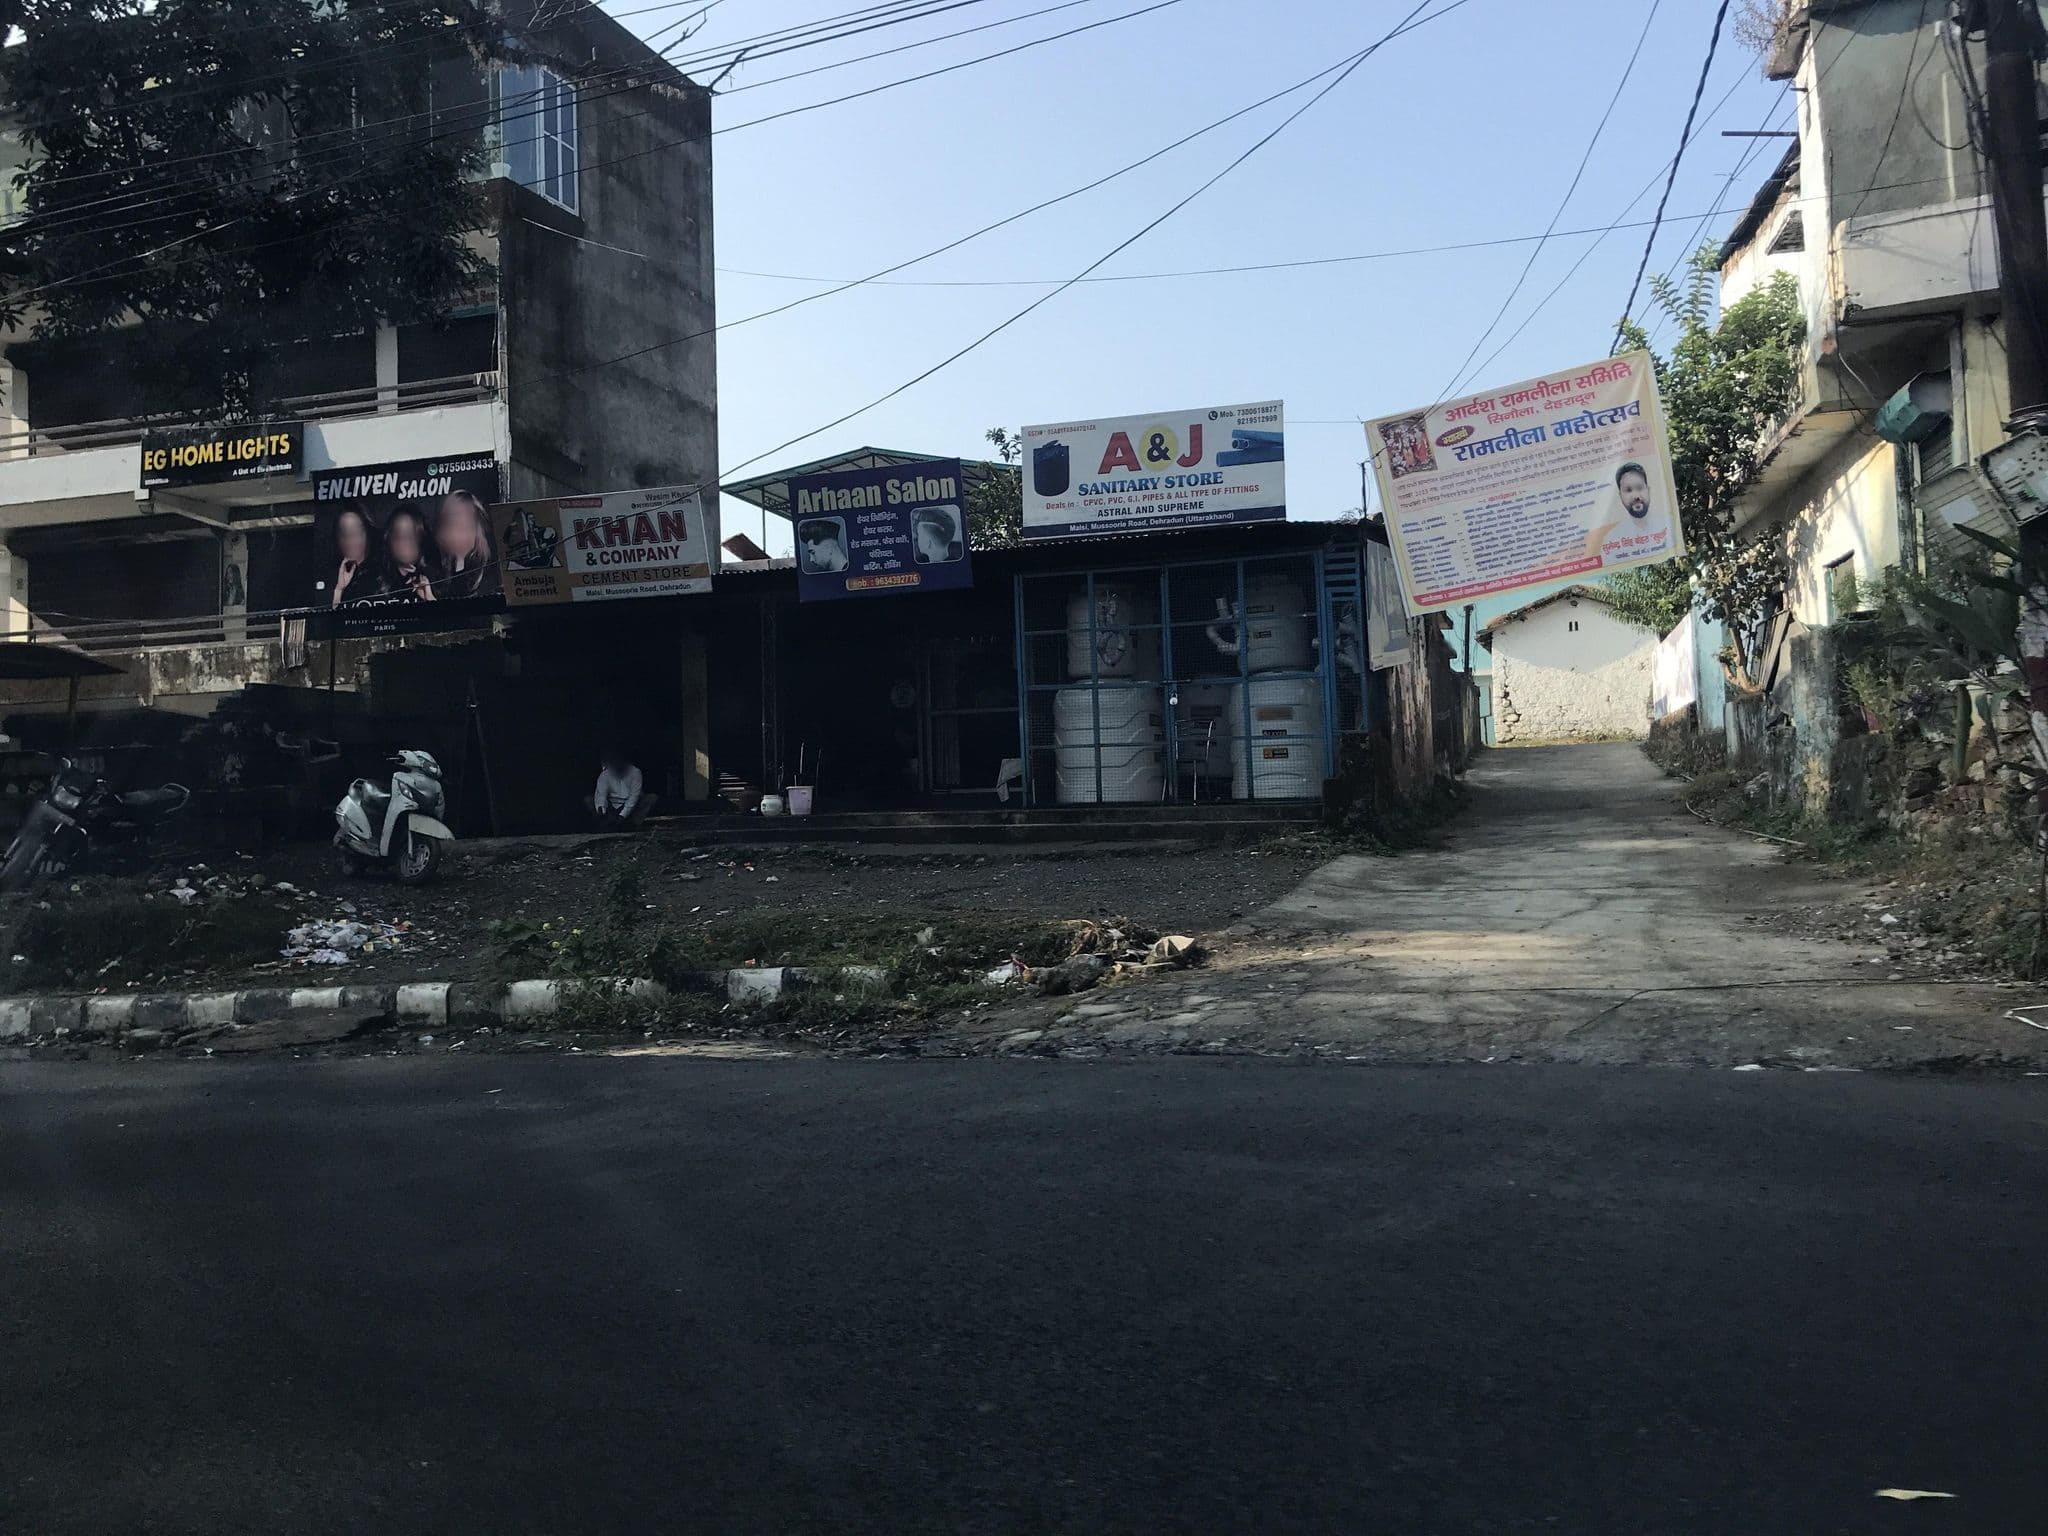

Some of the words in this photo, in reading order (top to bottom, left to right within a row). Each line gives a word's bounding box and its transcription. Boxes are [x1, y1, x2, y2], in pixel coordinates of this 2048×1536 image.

[1500, 380, 1571, 409] रामलीला
[1575, 361, 1633, 389] समिति
[1544, 390, 1596, 412] देहरादून
[1452, 427, 1547, 462] रामलीला
[1550, 399, 1641, 437] महोत्सव
[170, 442, 224, 467] HOME
[227, 433, 290, 461] LIGHTS
[438, 458, 494, 474] 8755033433
[318, 472, 399, 500] ENLIVEN
[398, 476, 452, 499] SALON
[797, 484, 882, 513] Arhaan
[885, 476, 956, 505] Salon
[1078, 476, 1160, 496] SANITARY
[1164, 471, 1224, 490] STORE
[1046, 501, 1066, 510] Deals
[1142, 493, 1165, 502] PIPES
[1166, 492, 1173, 500] &
[1175, 490, 1189, 499] ALL
[1190, 489, 1209, 498] TYPE
[1212, 488, 1223, 496] OF
[1224, 484, 1260, 495] FITTINGS
[1097, 505, 1134, 518] ASTRAL
[1135, 504, 1154, 515] AND
[1157, 500, 1205, 513] SUPREME
[573, 510, 687, 550] KHAN
[1090, 521, 1127, 531] Mussoorie
[1127, 519, 1148, 528] Road,
[1149, 516, 1184, 526] Dehradun
[1185, 512, 1235, 525] (Uttarakhand)
[586, 552, 597, 566] &
[599, 545, 681, 565] COMPANY
[582, 570, 638, 585] CEMENT
[643, 566, 691, 581] STORE
[515, 586, 558, 599] Cement
[659, 583, 692, 593] Dehradun
[374, 624, 396, 632] PARIS
